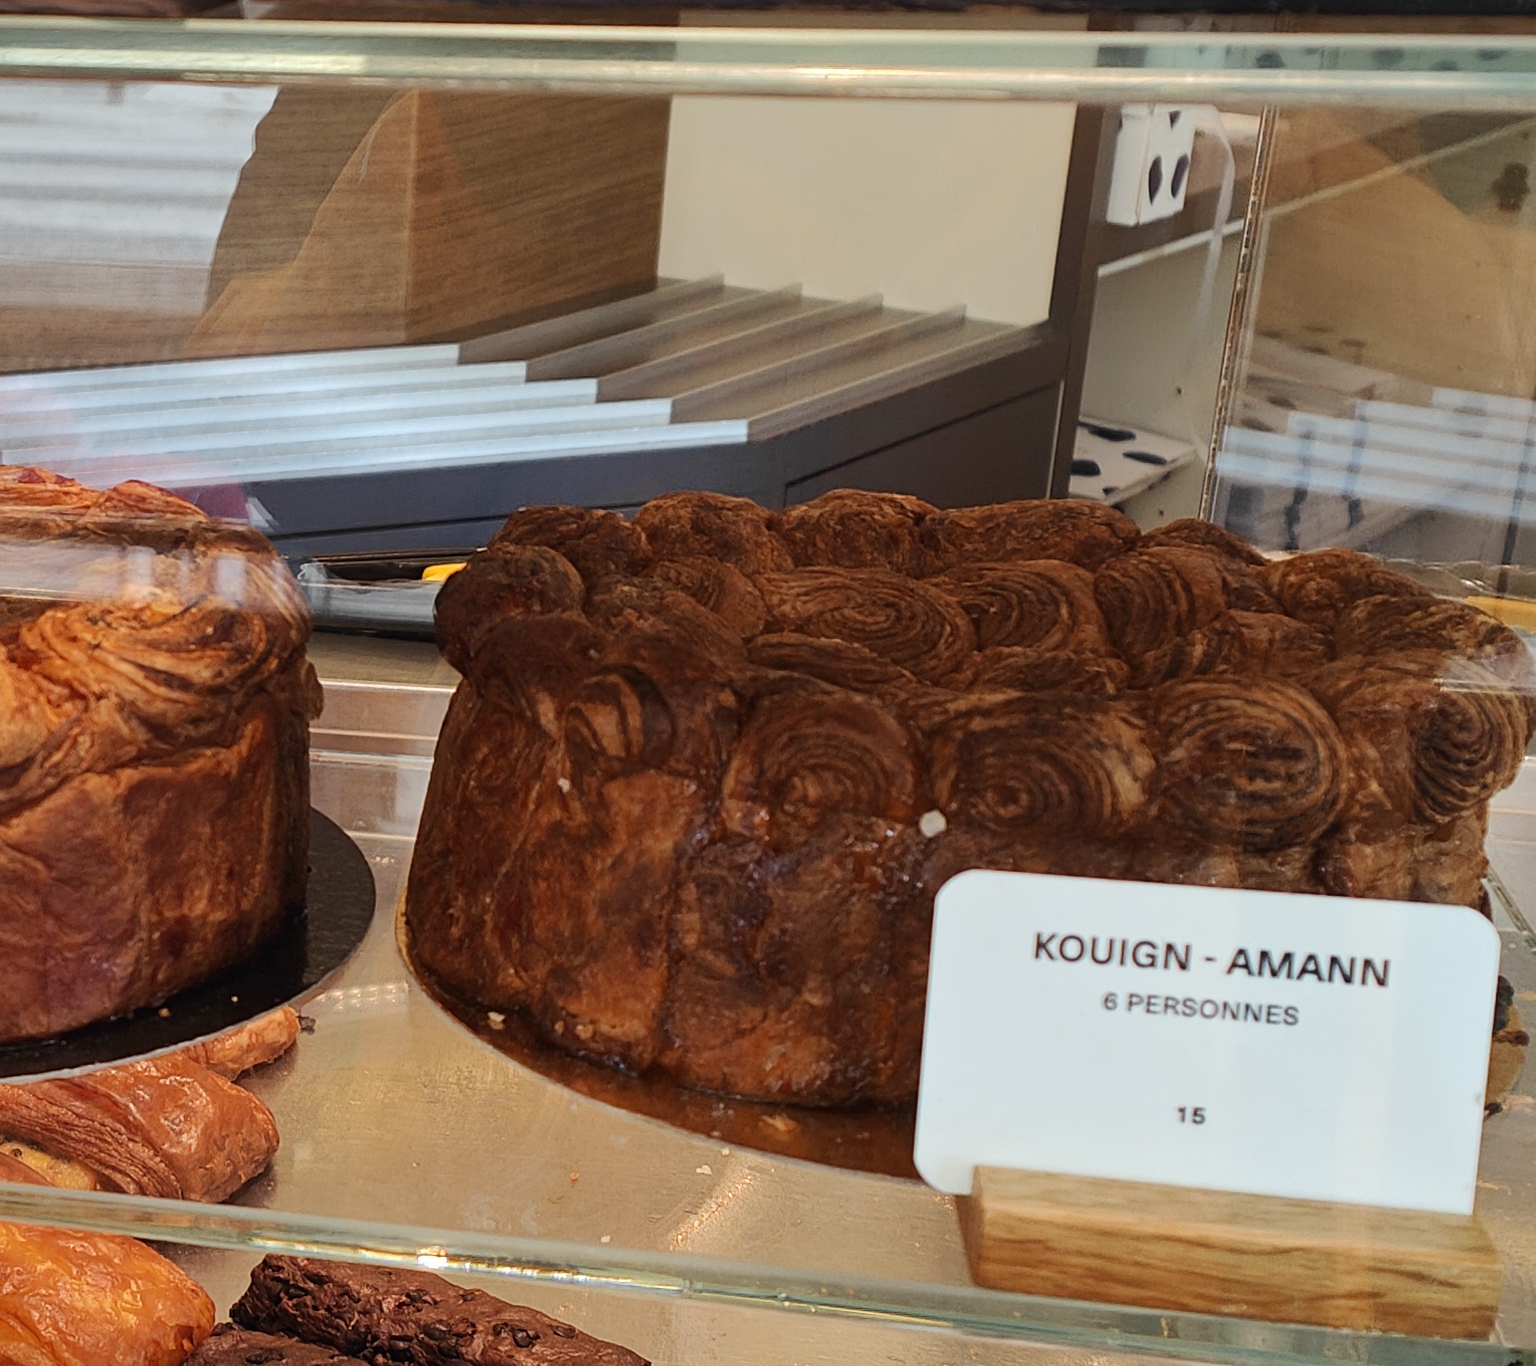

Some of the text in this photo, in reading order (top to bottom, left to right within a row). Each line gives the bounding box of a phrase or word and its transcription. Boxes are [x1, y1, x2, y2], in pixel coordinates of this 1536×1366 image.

[1032, 931, 1193, 972] KOUIGN
[1227, 948, 1392, 987] AMANN
[1104, 993, 1301, 1027] 6 PERSONNES
[1177, 1106, 1206, 1125] 15
